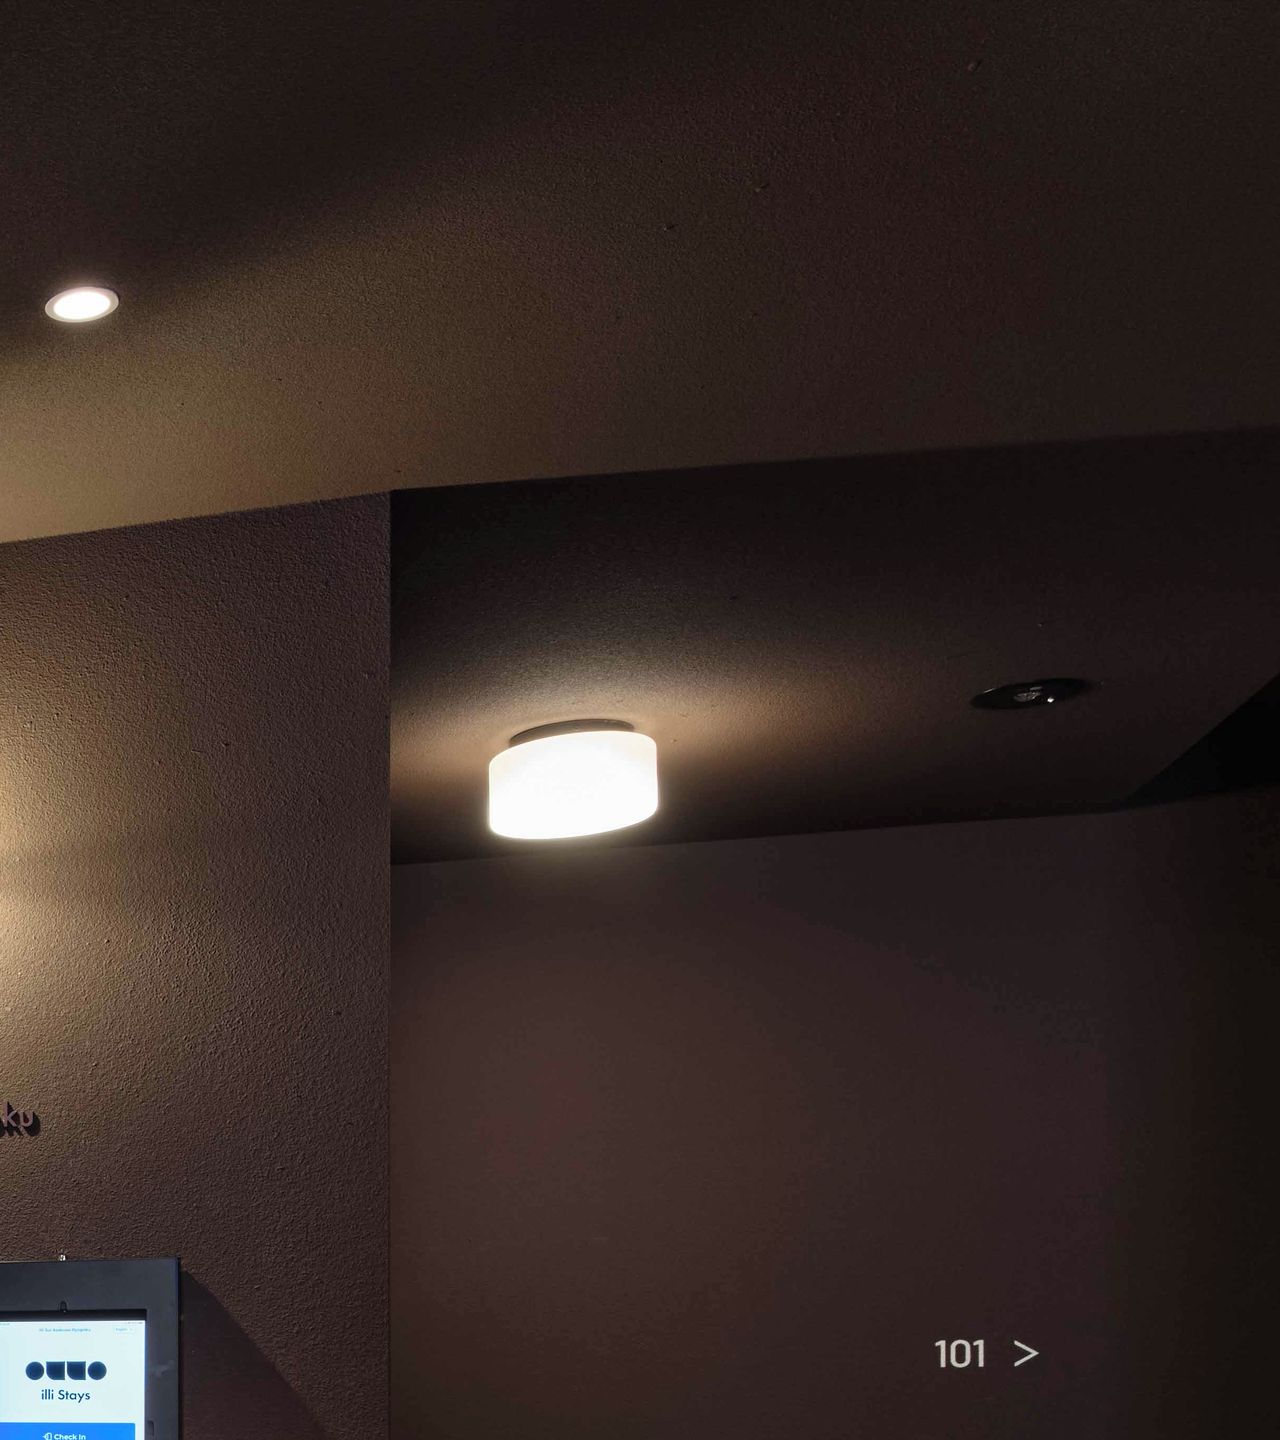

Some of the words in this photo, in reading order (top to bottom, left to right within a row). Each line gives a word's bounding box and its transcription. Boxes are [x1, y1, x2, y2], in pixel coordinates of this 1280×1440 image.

[934, 1339, 985, 1368] 101
[41, 1389, 54, 1400] illi
[57, 1389, 91, 1404] Stays
[53, 1433, 77, 1440] Check
[78, 1433, 87, 1440] In
